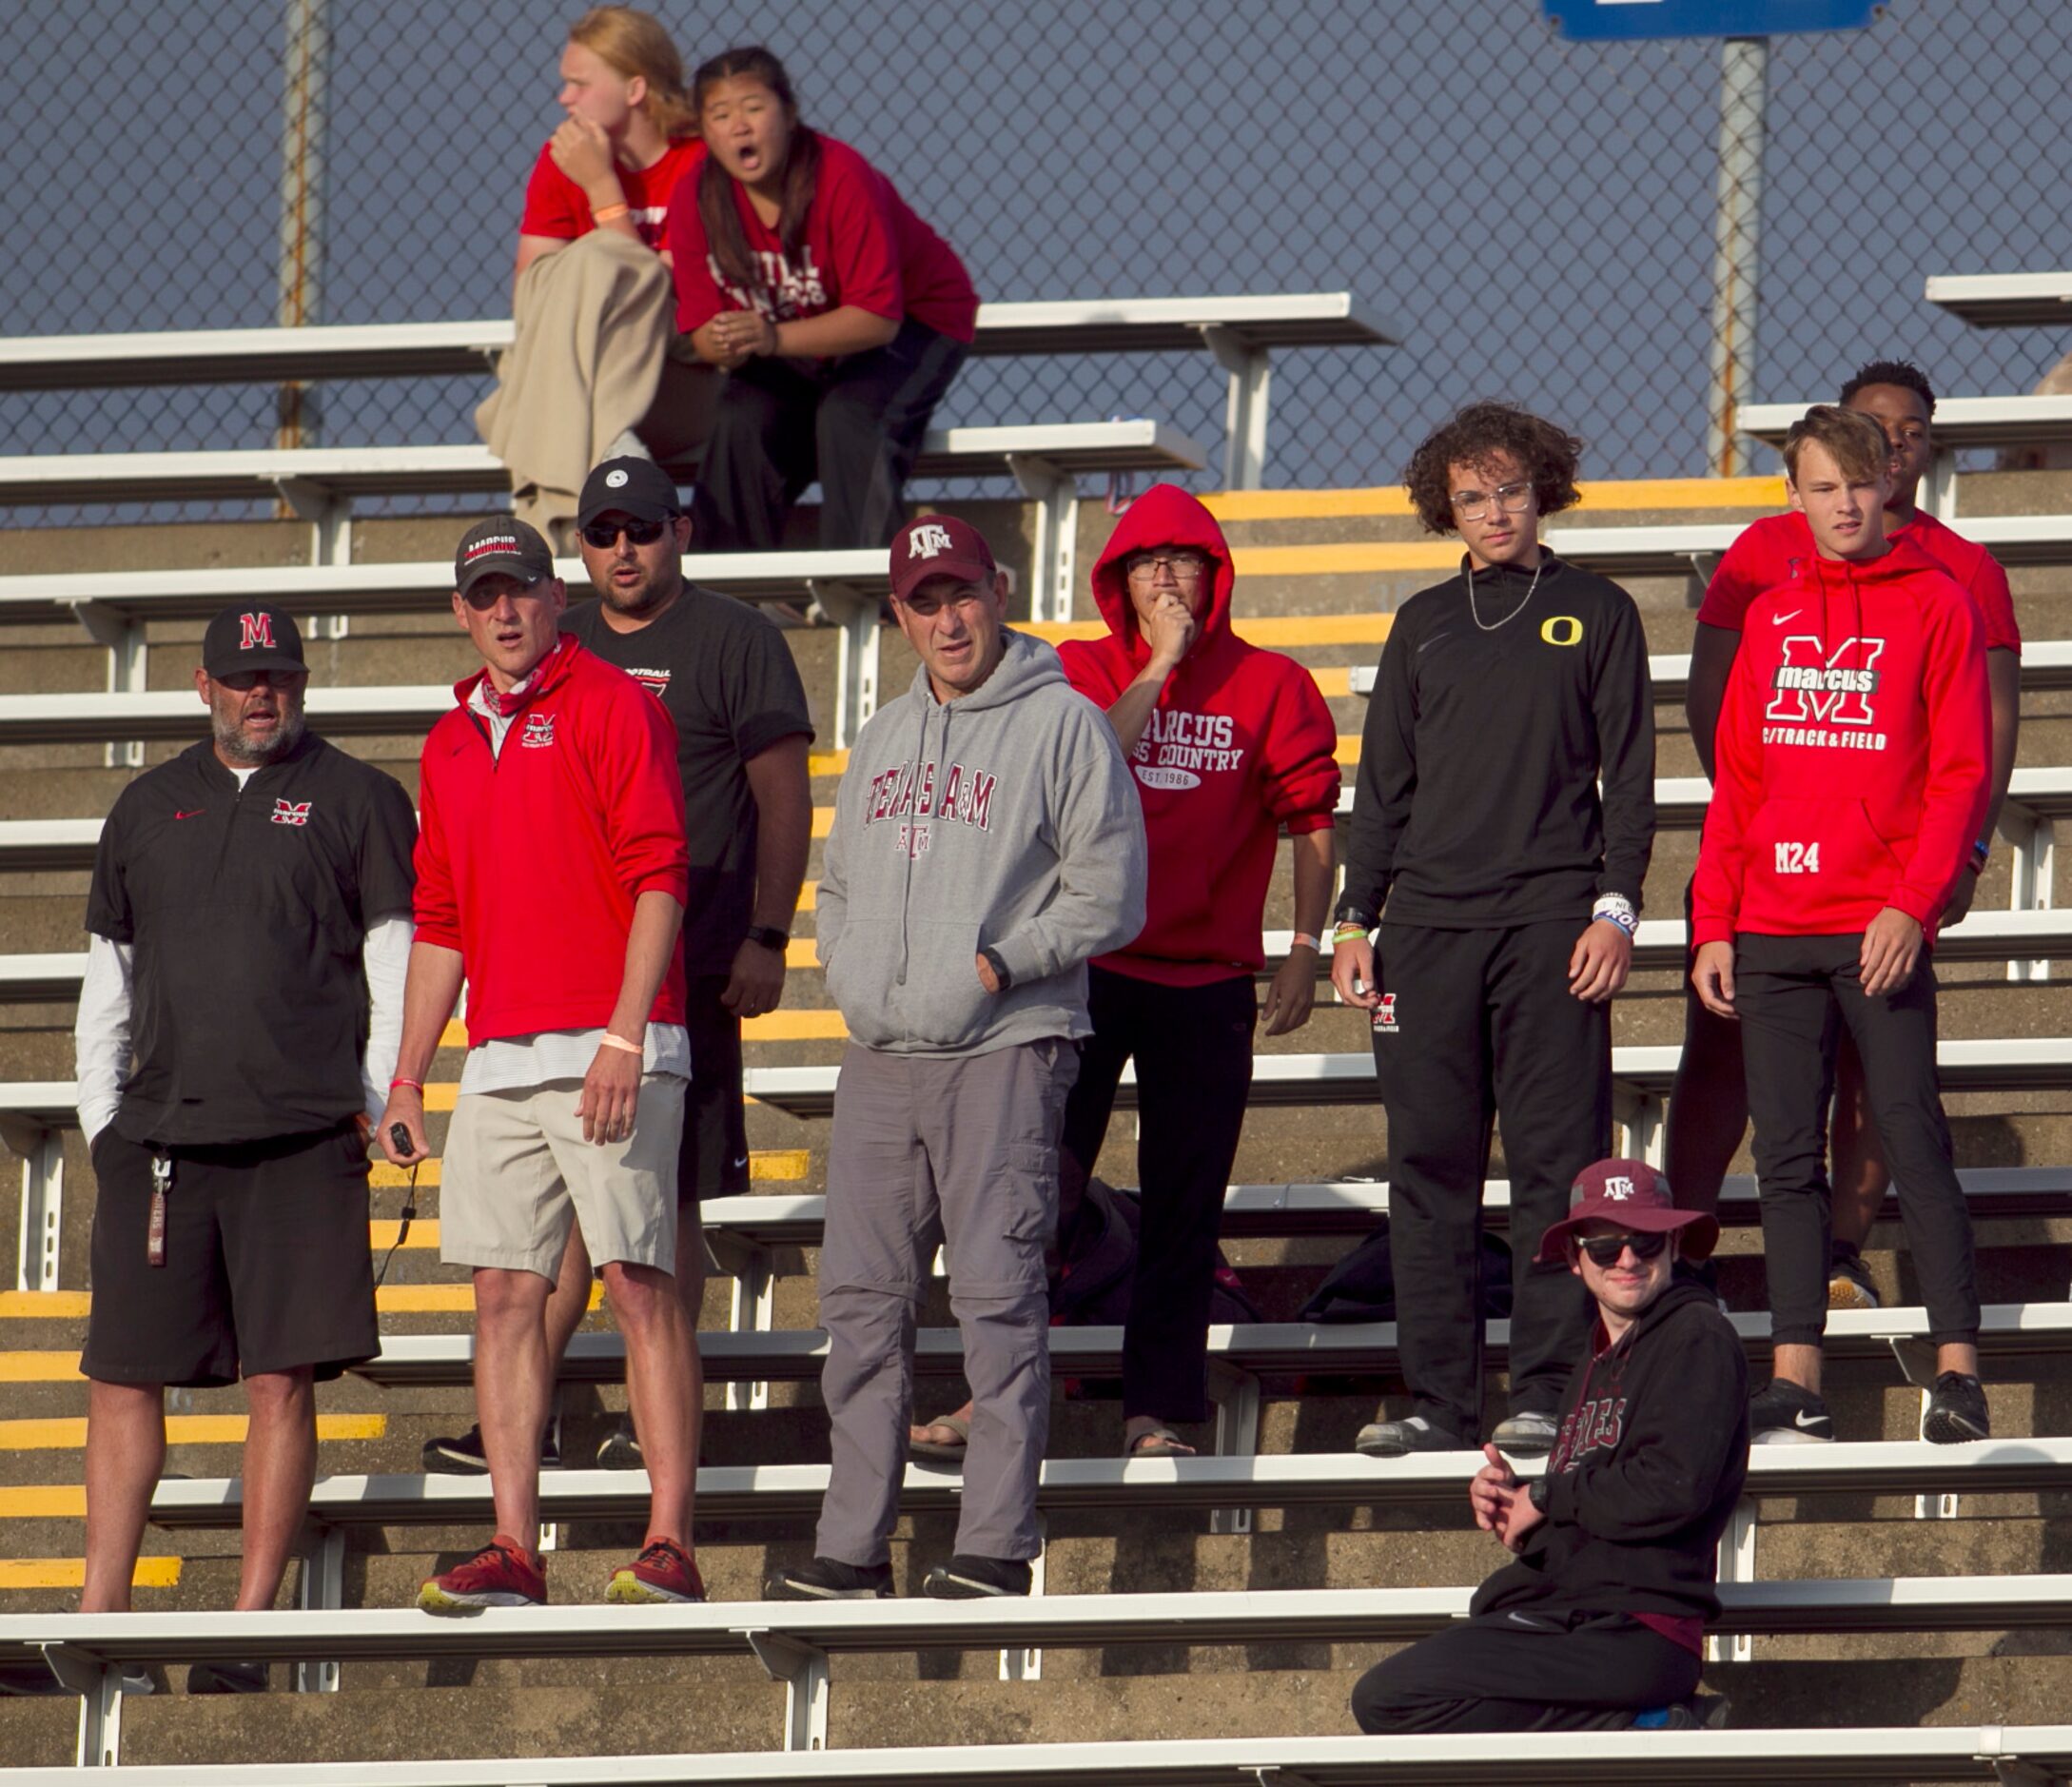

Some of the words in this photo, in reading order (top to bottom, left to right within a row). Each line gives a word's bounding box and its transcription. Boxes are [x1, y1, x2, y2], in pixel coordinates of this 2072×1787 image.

[240, 612, 277, 650] M
[1541, 616, 1583, 646] O
[1766, 636, 1886, 725] M
[1776, 666, 1874, 692] marcus
[1142, 707, 1234, 749] ARCUS
[1841, 732, 1886, 751] FIELD
[1157, 742, 1244, 772] COUNTRY
[1164, 773, 1189, 786] 1986
[864, 760, 935, 830] TEXAS
[939, 762, 998, 832] A&M
[270, 797, 312, 826] M
[1774, 842, 1820, 874] M24
